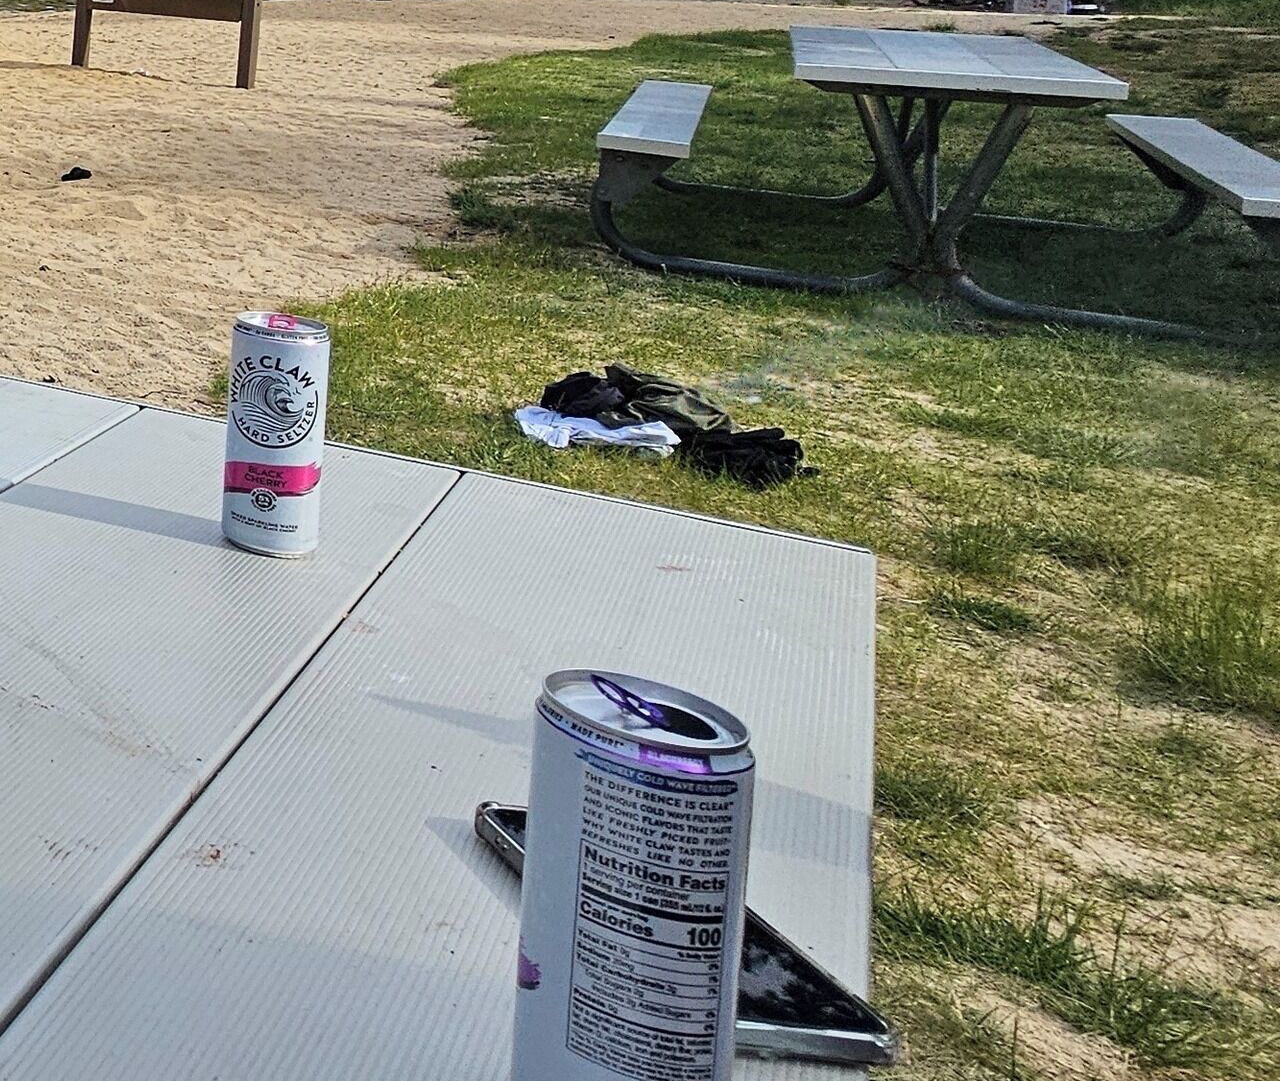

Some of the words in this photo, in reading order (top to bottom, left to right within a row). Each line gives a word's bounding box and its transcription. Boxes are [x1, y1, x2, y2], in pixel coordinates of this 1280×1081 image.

[231, 356, 256, 403] WHITE
[260, 355, 315, 389] CLAW
[238, 417, 270, 442] HARD
[277, 401, 315, 443] SELTZER
[244, 473, 288, 488] CHERRY
[248, 465, 284, 479] BLACK
[584, 771, 604, 786] THE
[608, 780, 682, 807] DIFFERENCE
[685, 801, 696, 810] IS
[584, 784, 602, 796] OUR
[603, 791, 637, 809] UNIQUE
[640, 803, 665, 817] COLD
[583, 796, 602, 808] AND
[604, 803, 640, 821] ICONIC
[642, 816, 685, 832] FLAVORS
[687, 824, 709, 834] THAT
[583, 806, 603, 820] LIKE
[609, 817, 657, 837] FRESHLY
[661, 832, 700, 845] PICKED
[581, 828, 640, 855] REFRESHES
[647, 851, 672, 863] LIKE
[678, 858, 694, 867] NO
[582, 817, 605, 831] WHY
[608, 828, 642, 845] WHITE
[645, 839, 676, 852] CLAW
[678, 846, 712, 857] TASTES
[584, 845, 674, 887] Nutrition
[680, 874, 726, 890] Facts
[580, 900, 654, 937] Calories
[687, 927, 721, 946] 100
